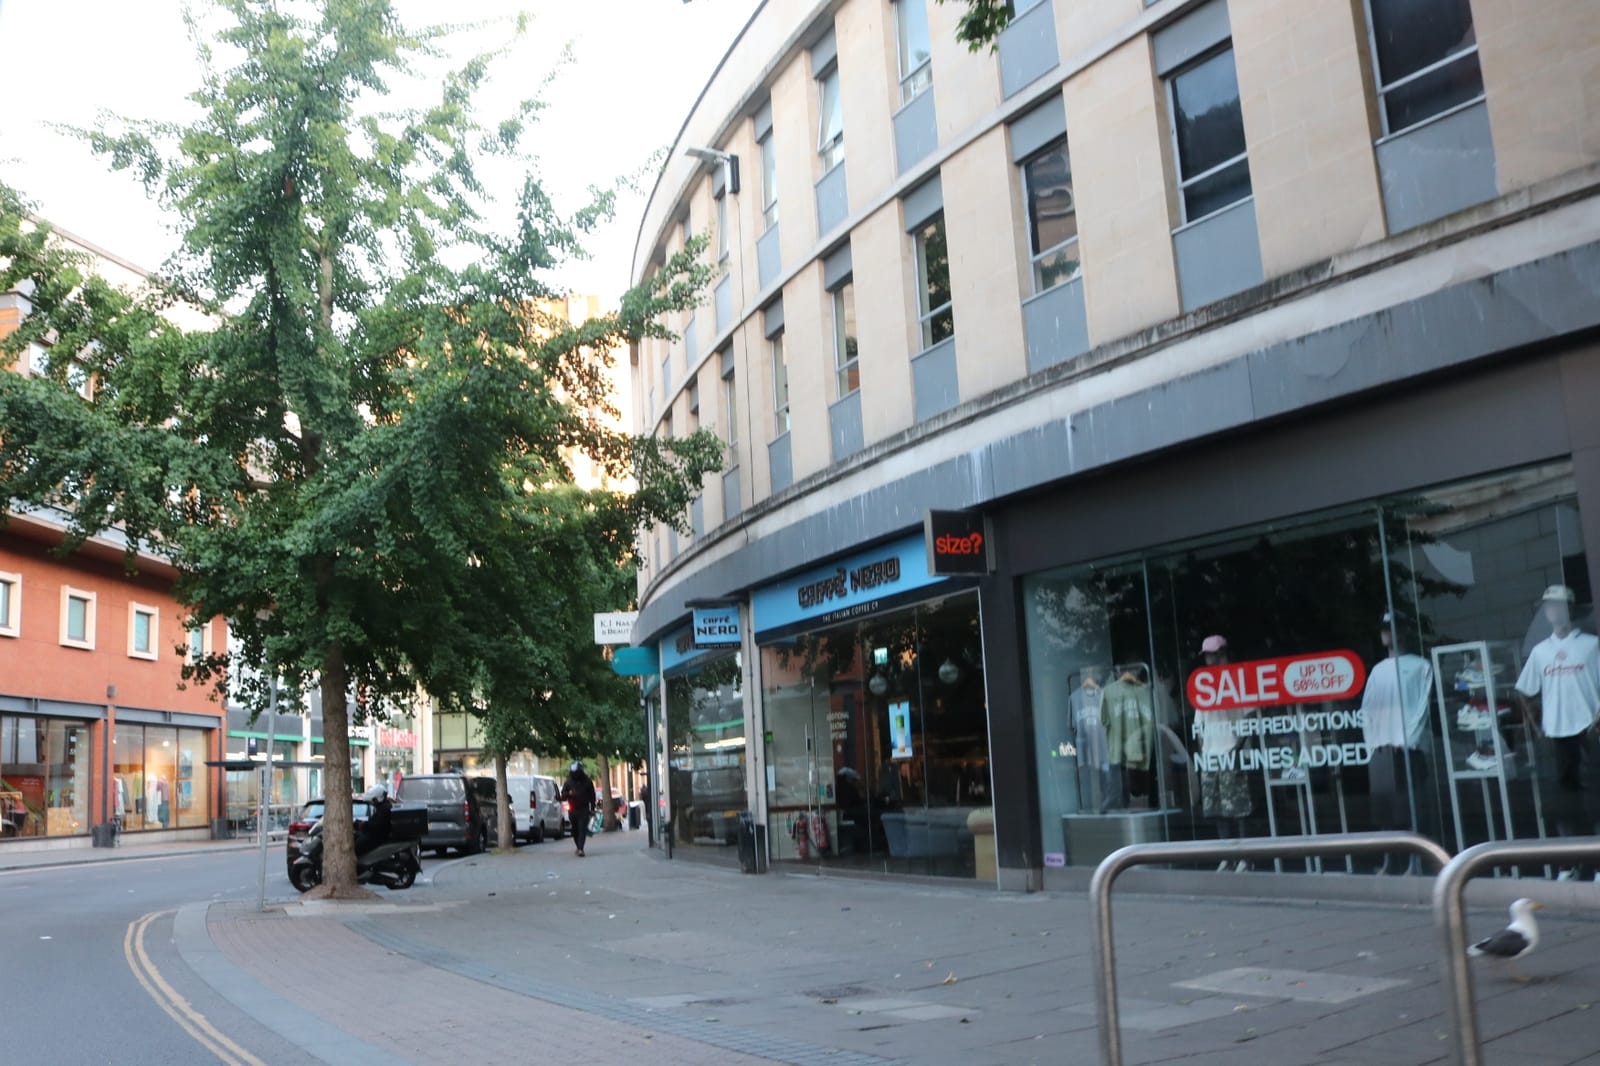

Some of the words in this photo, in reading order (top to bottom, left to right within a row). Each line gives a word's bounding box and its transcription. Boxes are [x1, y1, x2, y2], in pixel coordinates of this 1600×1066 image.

[936, 532, 983, 554] size?
[850, 557, 900, 592] NERO
[851, 602, 870, 616] COFFEE
[697, 624, 738, 636] NERO
[1299, 663, 1316, 678] UP
[1318, 661, 1335, 676] TO
[1194, 663, 1280, 707] SALE
[1262, 709, 1368, 735] REDUCTIONS
[1193, 750, 1236, 773] NEW
[1239, 746, 1294, 771] LINES
[1297, 742, 1372, 768] ADDED
